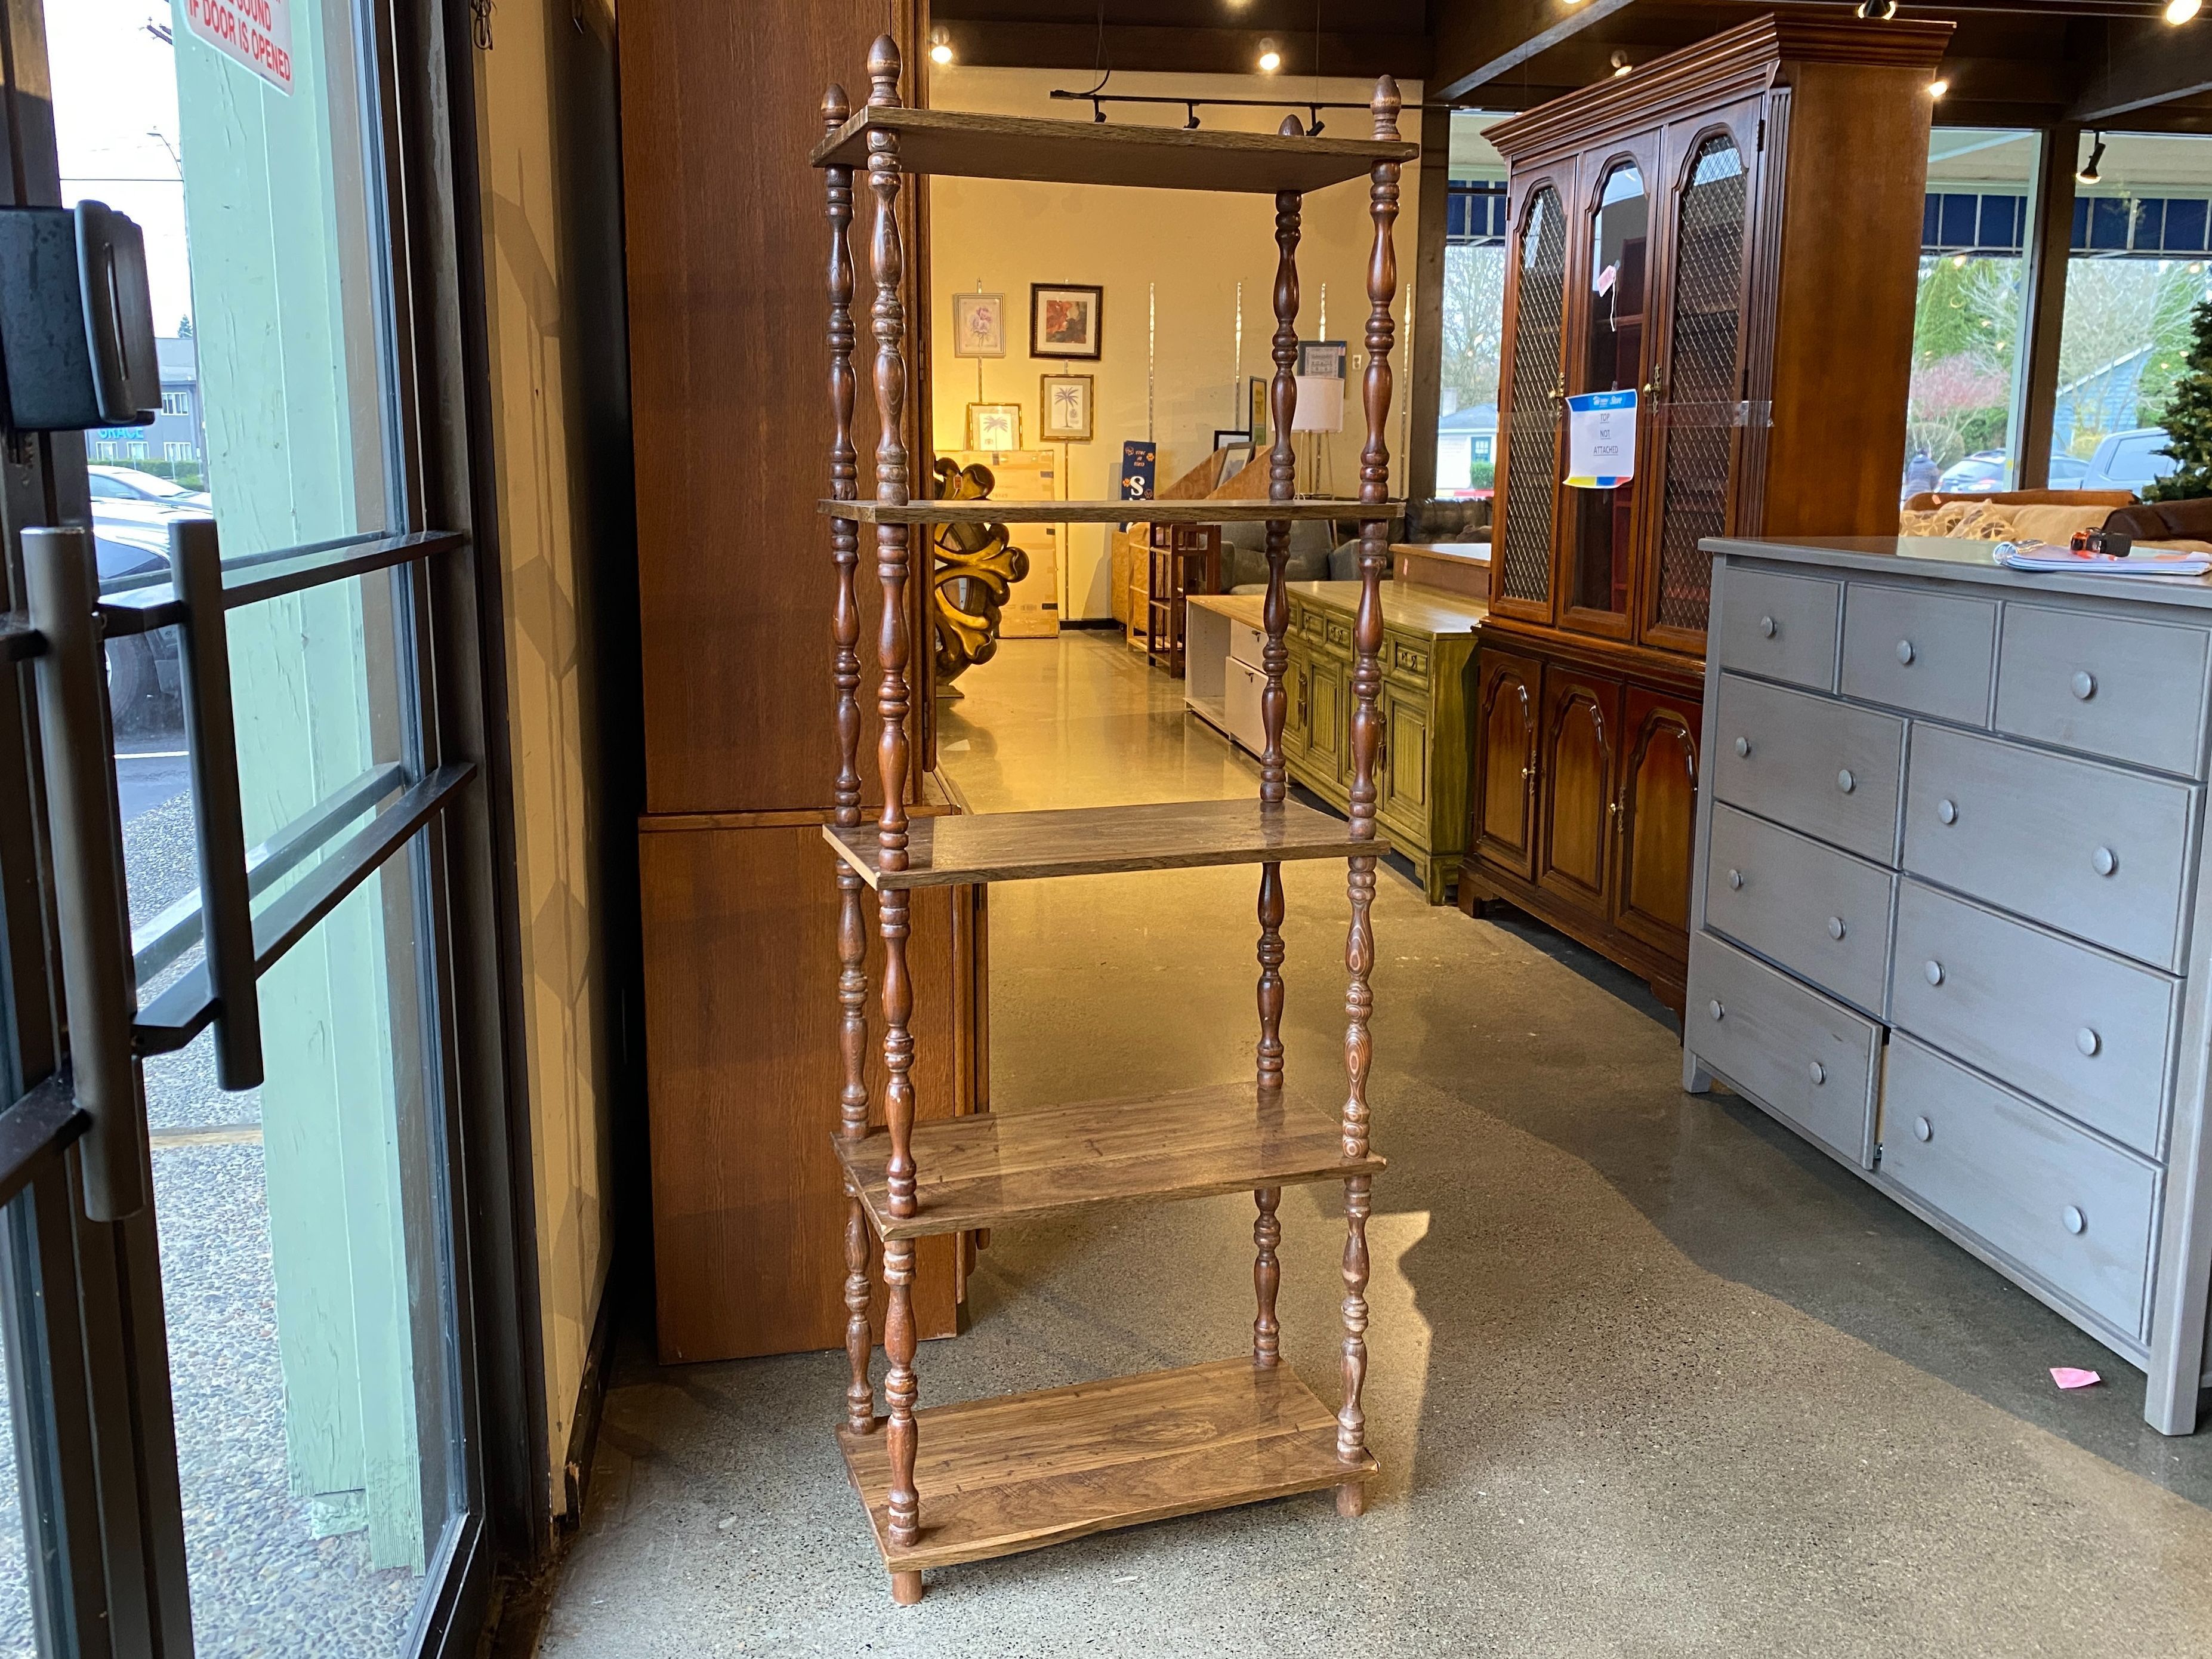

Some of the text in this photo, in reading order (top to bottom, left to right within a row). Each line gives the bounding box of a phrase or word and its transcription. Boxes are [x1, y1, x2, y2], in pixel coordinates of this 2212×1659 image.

[203, 0, 236, 45] DOOR
[238, 18, 249, 54] IS
[251, 29, 291, 82] OPENED
[1600, 413, 1610, 422] TOP
[1600, 429, 1610, 437] NOT
[1593, 445, 1618, 454] ATTACHED
[1130, 476, 1145, 496] S
